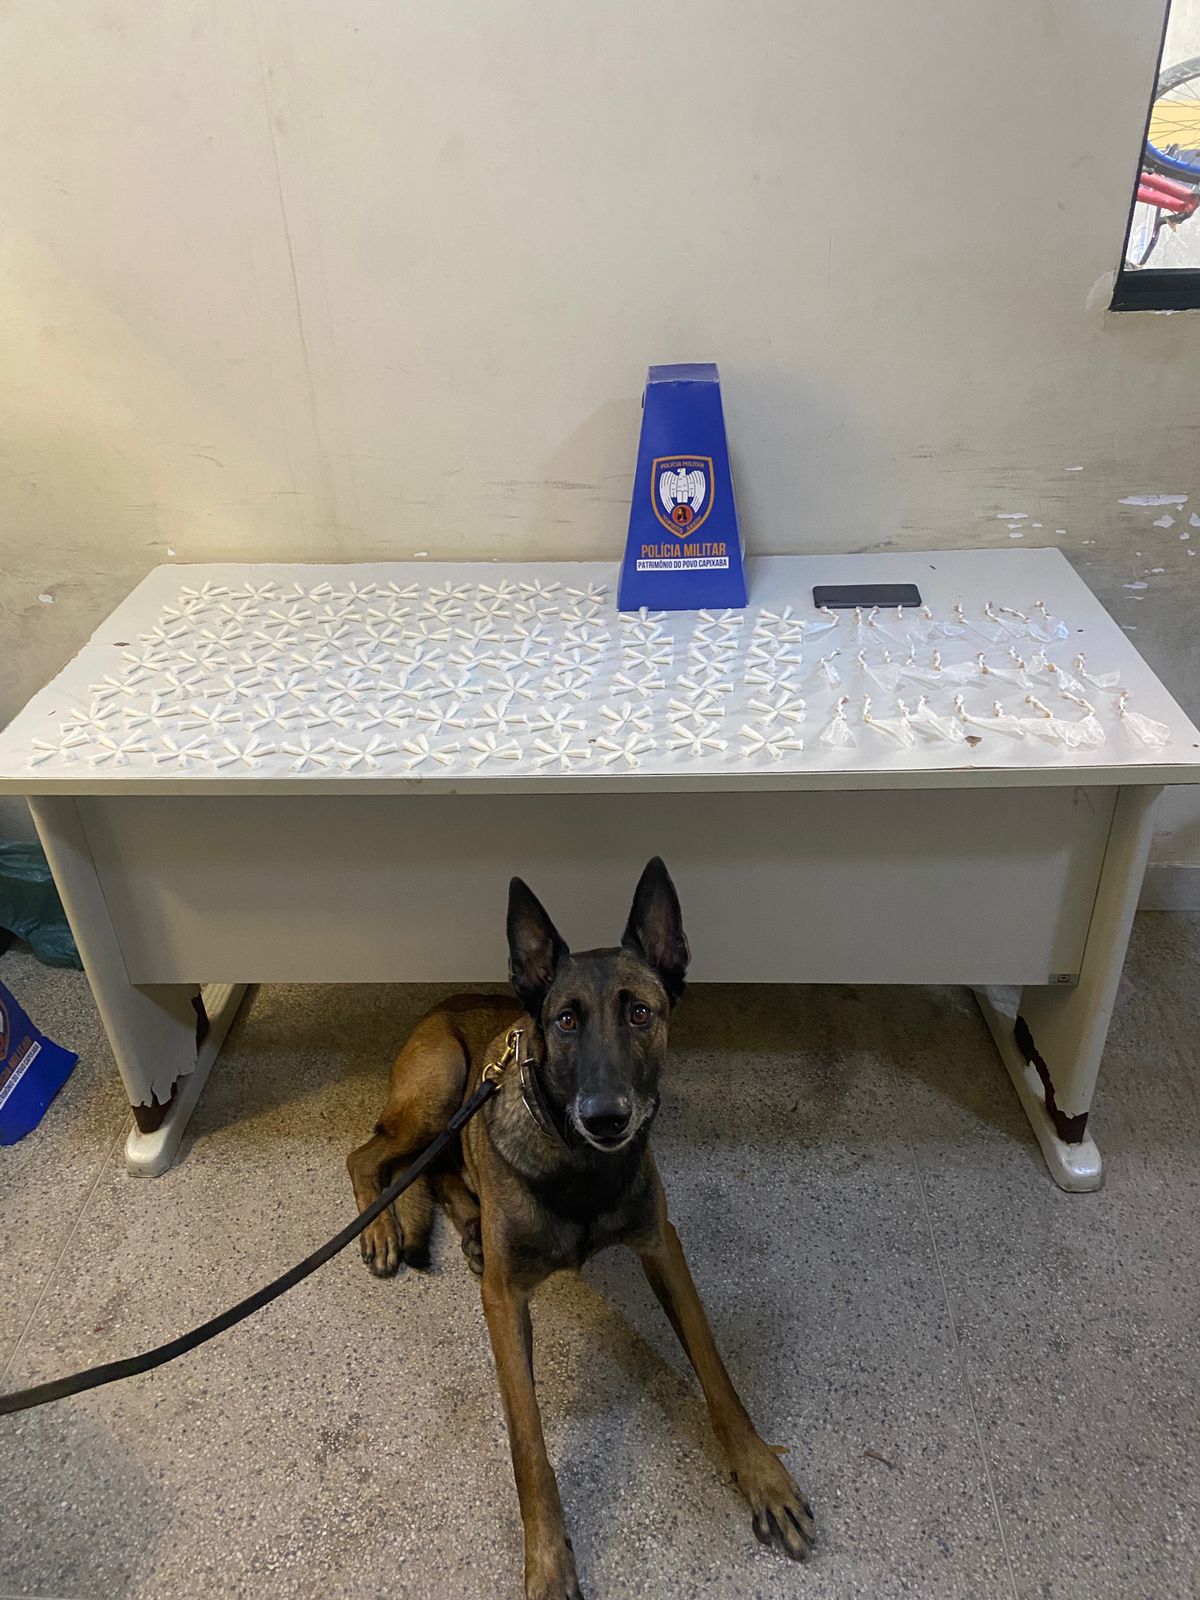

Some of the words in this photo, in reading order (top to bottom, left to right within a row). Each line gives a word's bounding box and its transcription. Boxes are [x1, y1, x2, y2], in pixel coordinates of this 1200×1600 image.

[682, 461, 704, 469] MILITAR
[641, 541, 681, 558] POLÍCIA
[683, 542, 726, 557] MILITAR
[638, 559, 672, 569] PATRIMÔNIO
[673, 560, 681, 568] DO
[682, 560, 697, 568] POVO
[698, 558, 727, 567] CAPIXABA
